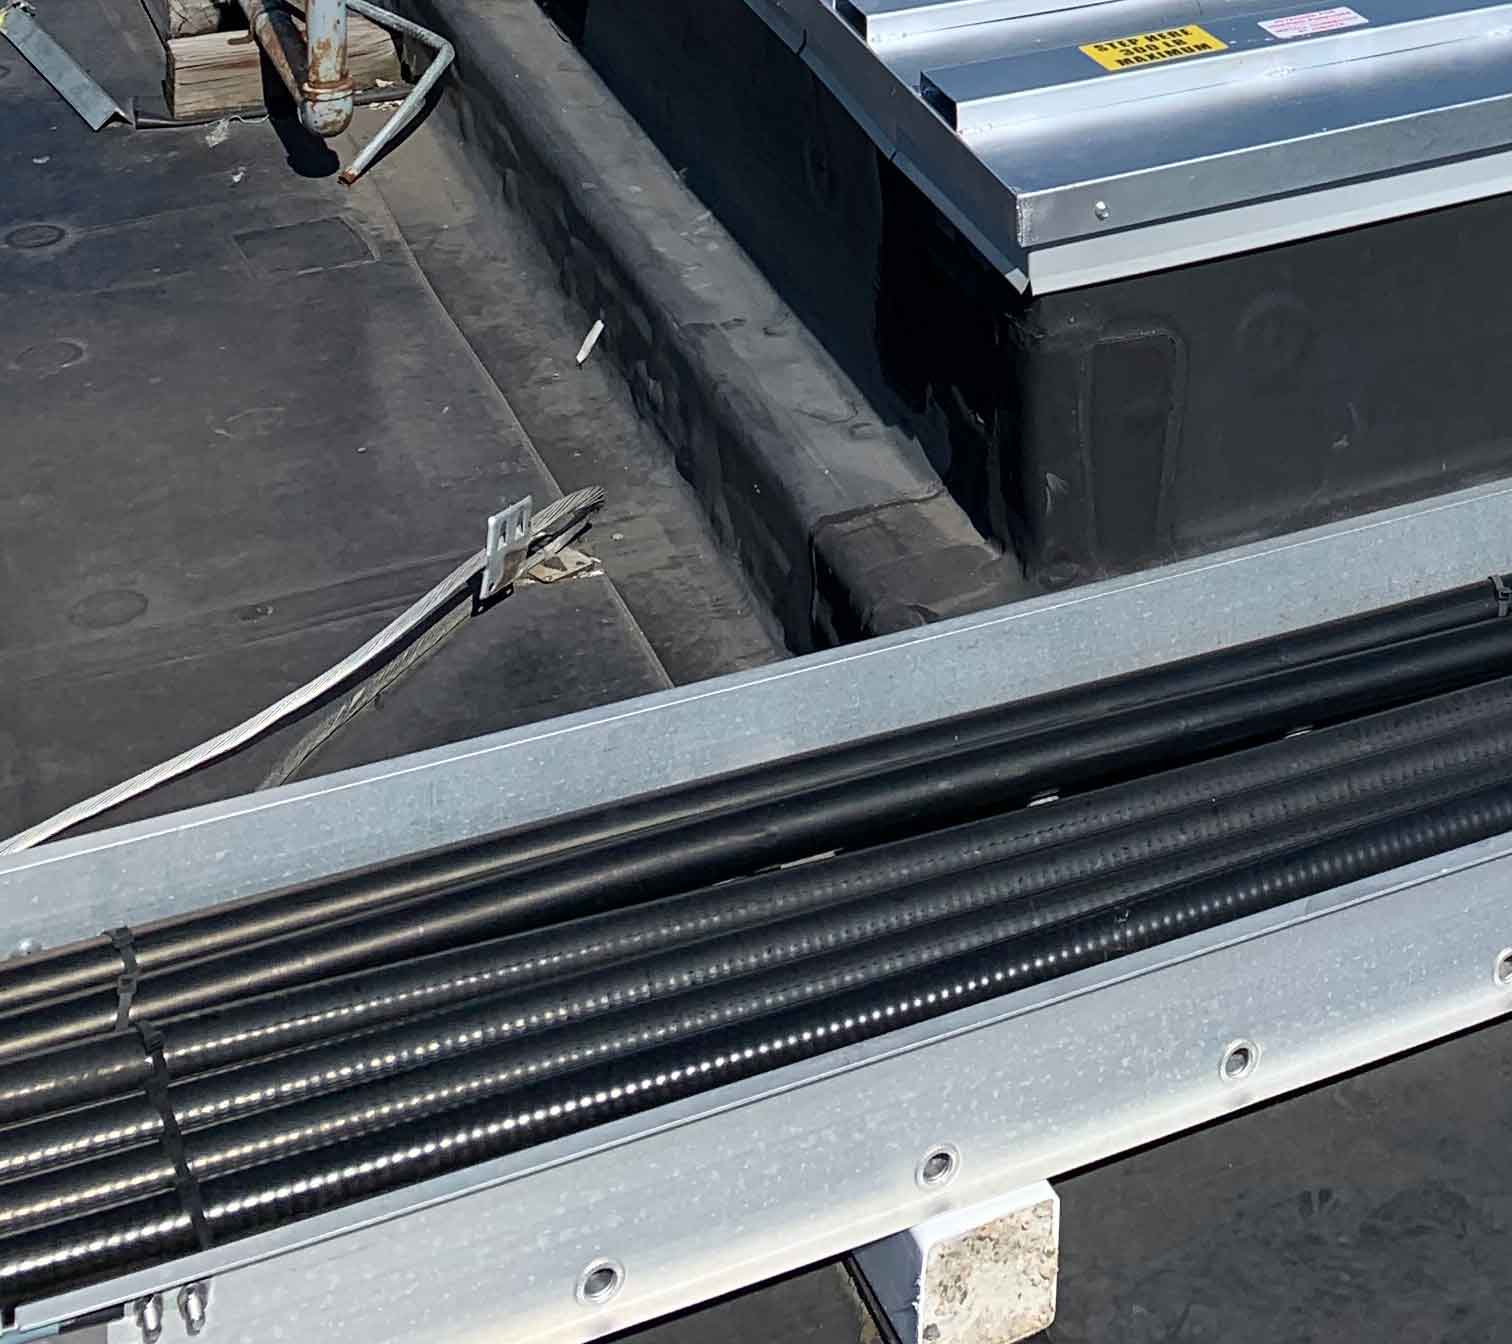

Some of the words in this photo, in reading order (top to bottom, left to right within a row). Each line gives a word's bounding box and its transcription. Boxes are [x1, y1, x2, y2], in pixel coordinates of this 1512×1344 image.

[1093, 37, 1138, 52] STEP
[1144, 28, 1193, 43] HERE
[1119, 43, 1160, 57] 300
[1115, 42, 1214, 67] MAXIMUM
